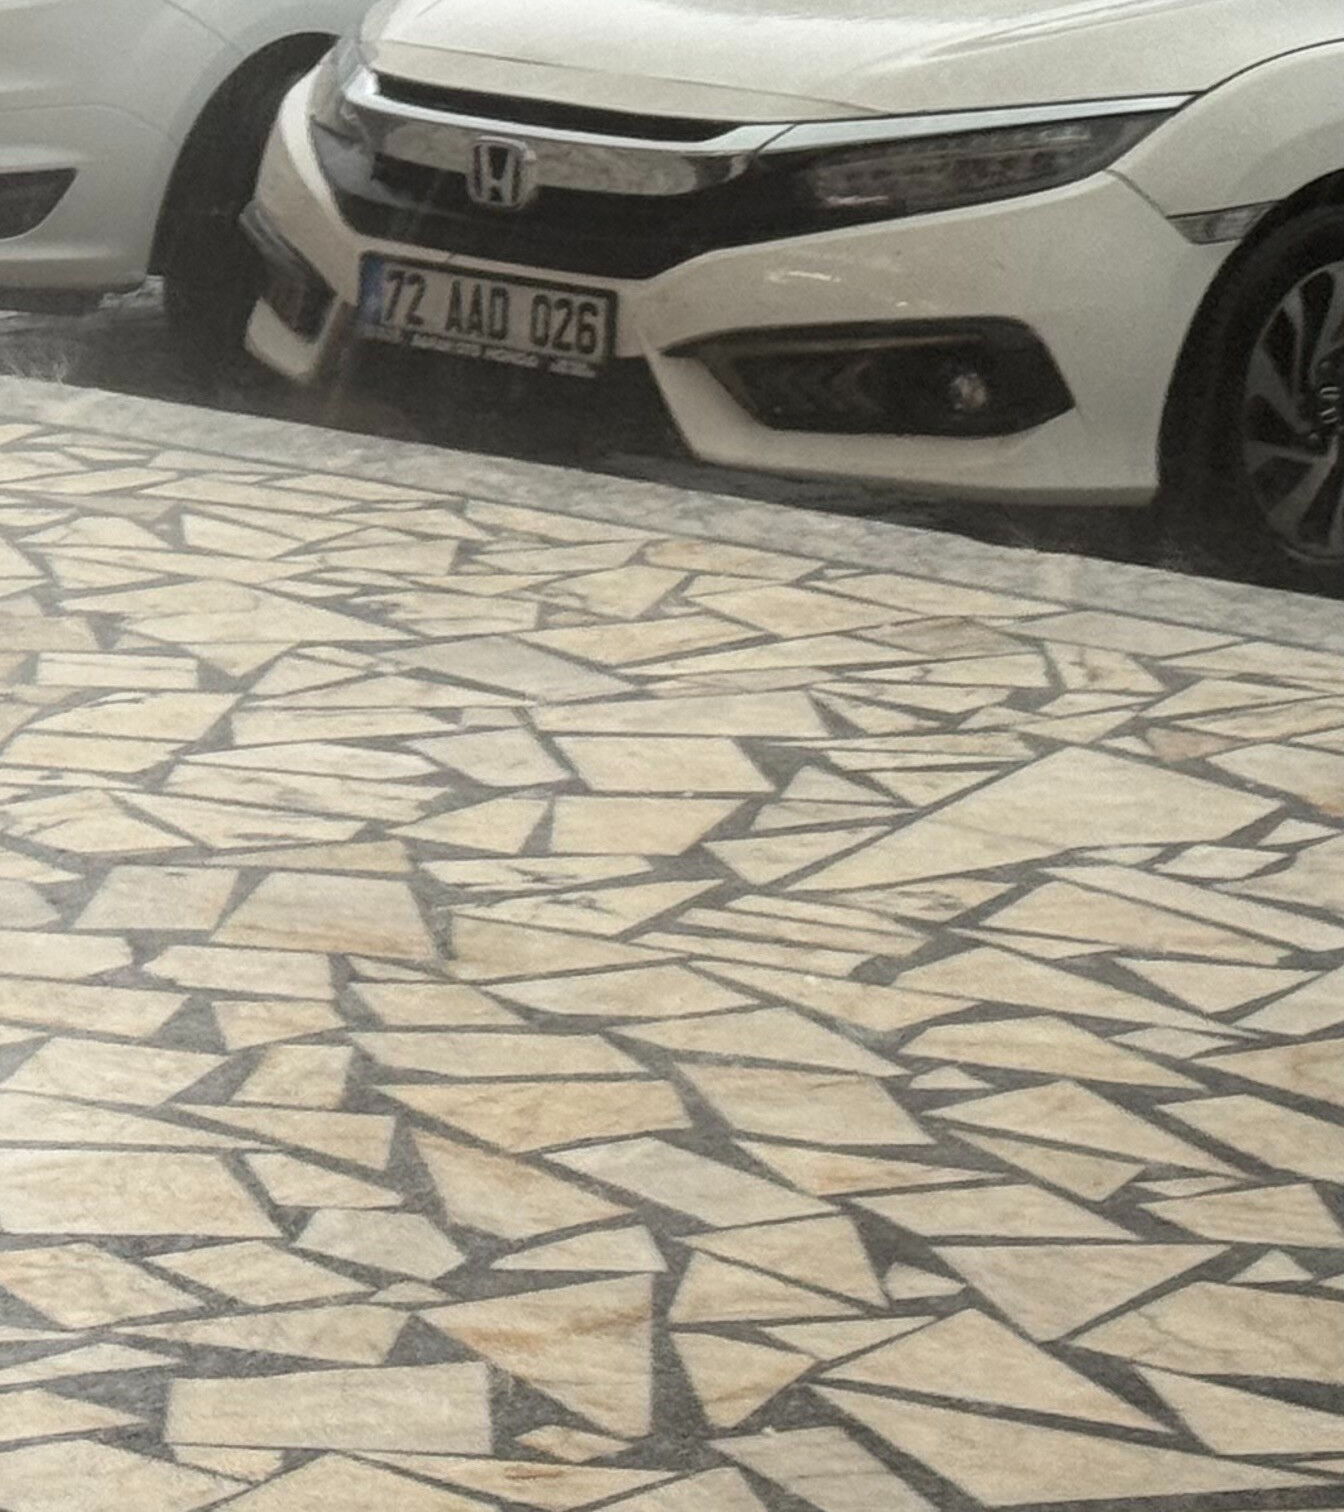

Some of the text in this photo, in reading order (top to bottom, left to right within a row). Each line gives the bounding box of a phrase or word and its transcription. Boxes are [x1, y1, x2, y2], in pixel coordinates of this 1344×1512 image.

[382, 269, 600, 355] 72 AAD 026
